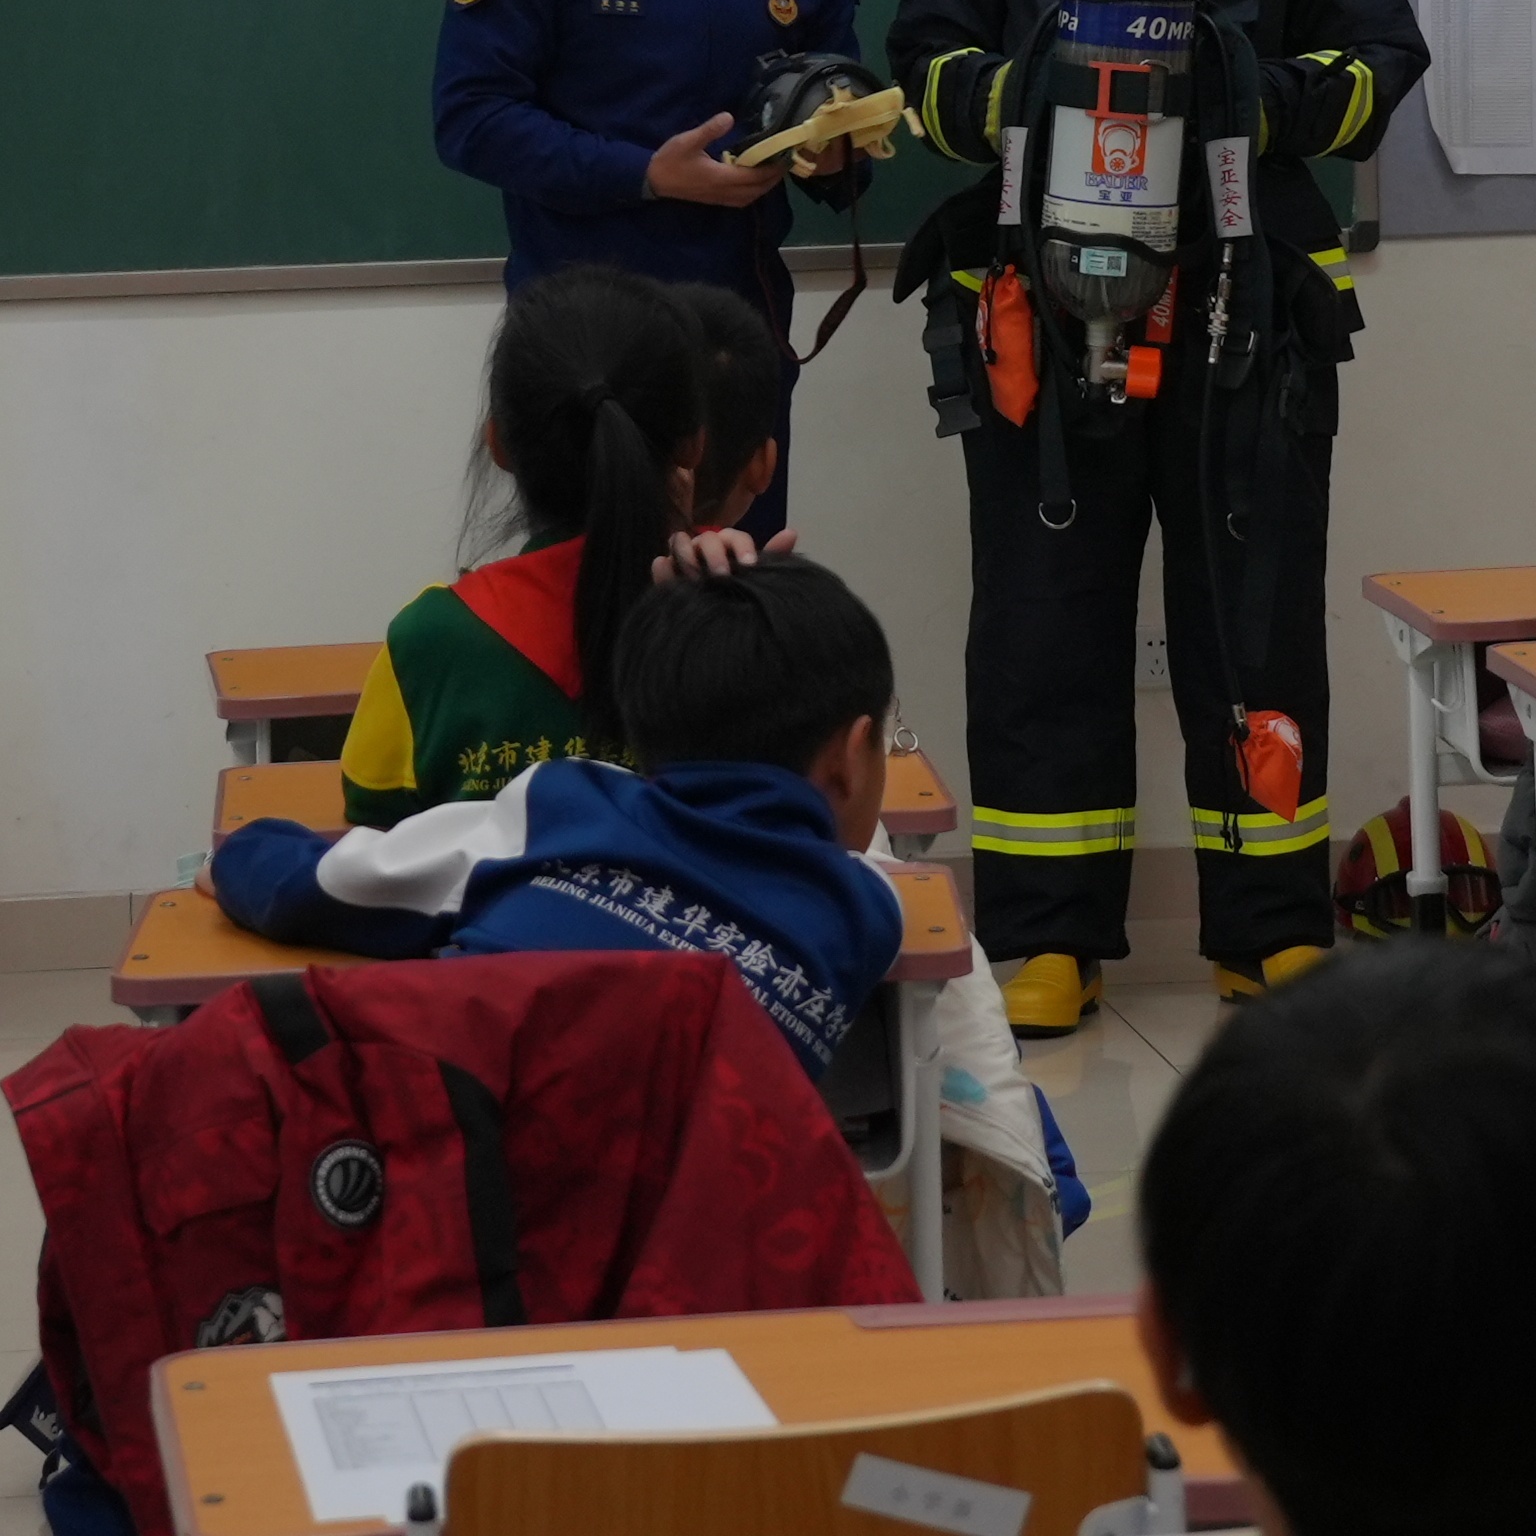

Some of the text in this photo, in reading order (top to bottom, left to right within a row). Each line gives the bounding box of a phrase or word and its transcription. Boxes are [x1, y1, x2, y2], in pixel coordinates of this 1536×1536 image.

[1057, 9, 1079, 32] Pa
[1098, 189, 1133, 203] 宝亚
[1218, 147, 1244, 228] 宝亚安全
[588, 893, 657, 936] JIANHUA
